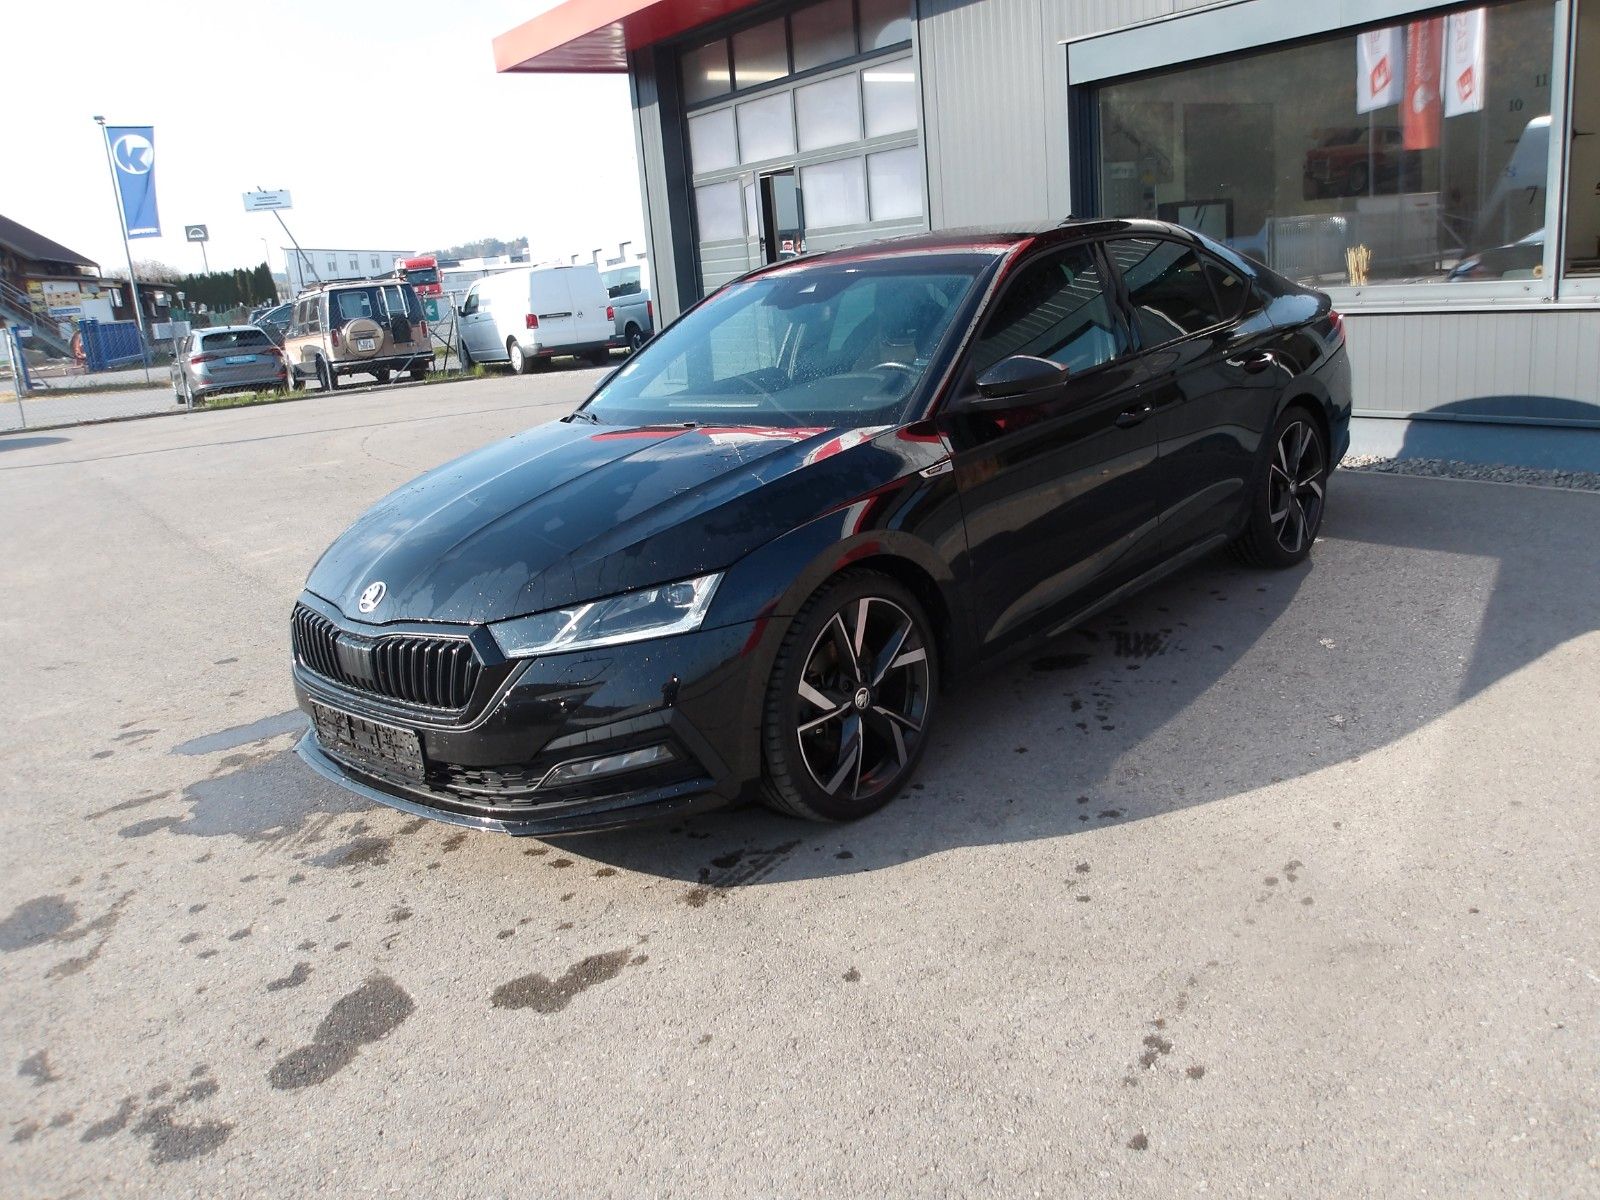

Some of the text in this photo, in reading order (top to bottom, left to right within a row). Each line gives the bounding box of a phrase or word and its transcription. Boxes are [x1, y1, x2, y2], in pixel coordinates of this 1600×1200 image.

[1535, 74, 1547, 87] 11
[1509, 99, 1523, 112] 10
[1526, 185, 1537, 204] 7
